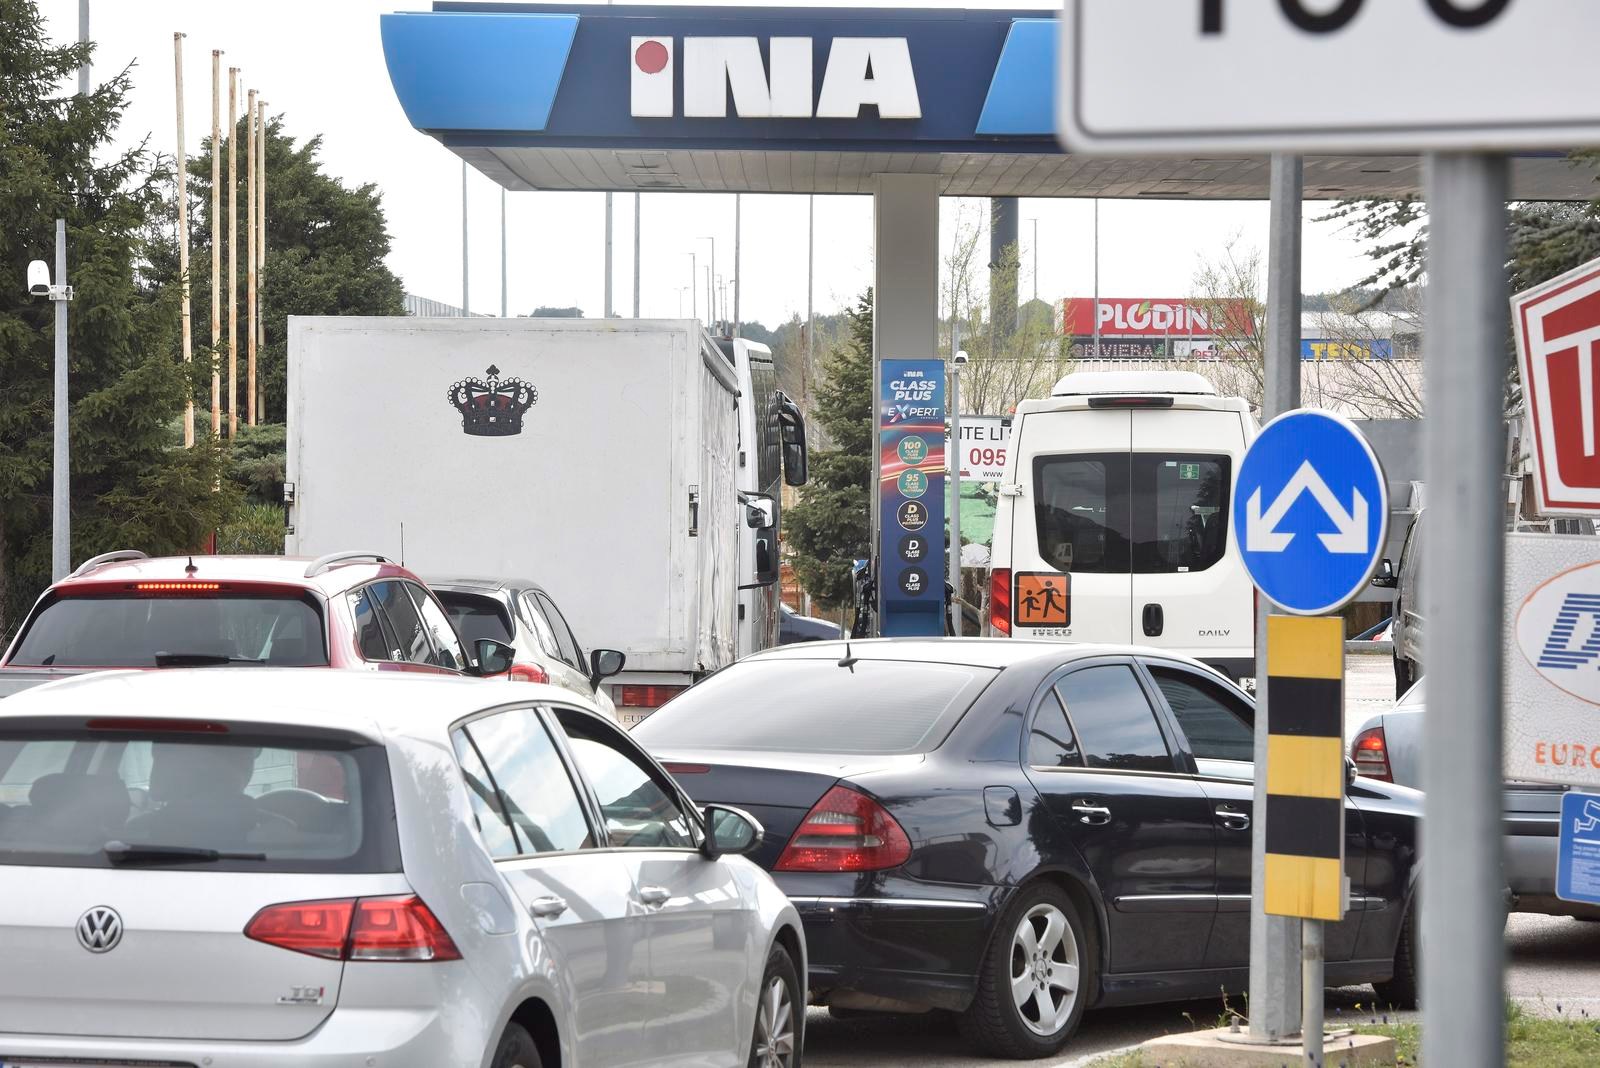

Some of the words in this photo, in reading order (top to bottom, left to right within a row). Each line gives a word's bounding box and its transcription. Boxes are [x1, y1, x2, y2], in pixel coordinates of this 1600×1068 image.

[630, 36, 922, 119] INA
[890, 380, 936, 390] CLASS
[895, 390, 932, 401] PLUS
[887, 403, 940, 423] EXPERT
[990, 427, 1003, 441] LI
[903, 441, 921, 450] 100
[969, 448, 1006, 466] 095
[906, 473, 920, 482] 95
[907, 504, 918, 514] D
[908, 540, 919, 550] D
[909, 573, 920, 583] D
[1032, 629, 1072, 637] IVECO
[1198, 629, 1231, 637] DAILY
